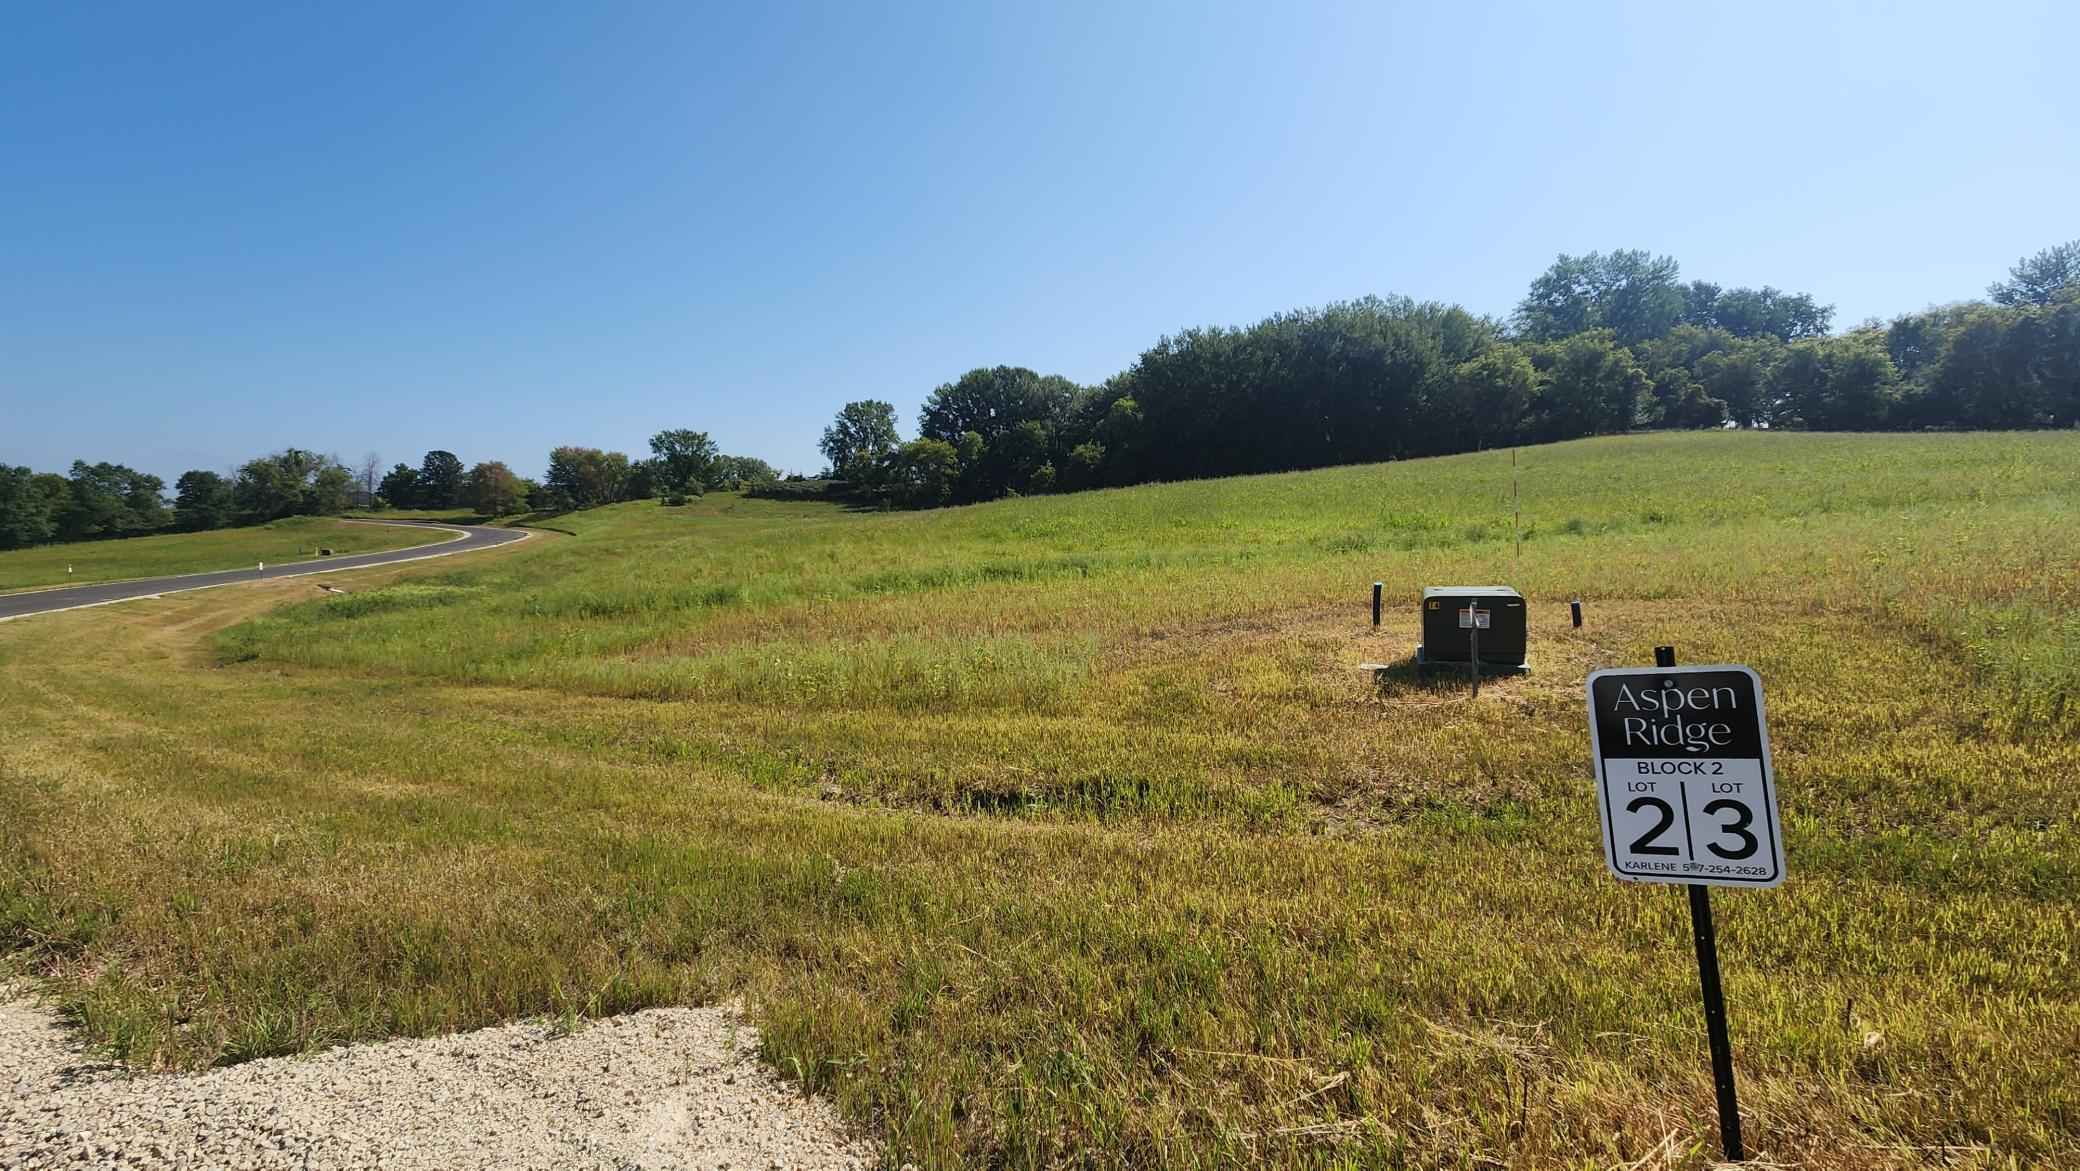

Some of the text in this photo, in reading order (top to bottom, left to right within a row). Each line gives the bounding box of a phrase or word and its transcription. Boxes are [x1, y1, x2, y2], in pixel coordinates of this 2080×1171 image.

[1614, 683, 1737, 718] Aspen
[1624, 714, 1732, 752] Ridge
[1637, 762, 1724, 775] BLOCK 2
[1628, 782, 1657, 792] LOT
[1711, 783, 1743, 793] LOT
[1626, 797, 1680, 856] 2
[1702, 798, 1759, 860] 3
[1625, 861, 1767, 876] KARLENE 57-254-2628
